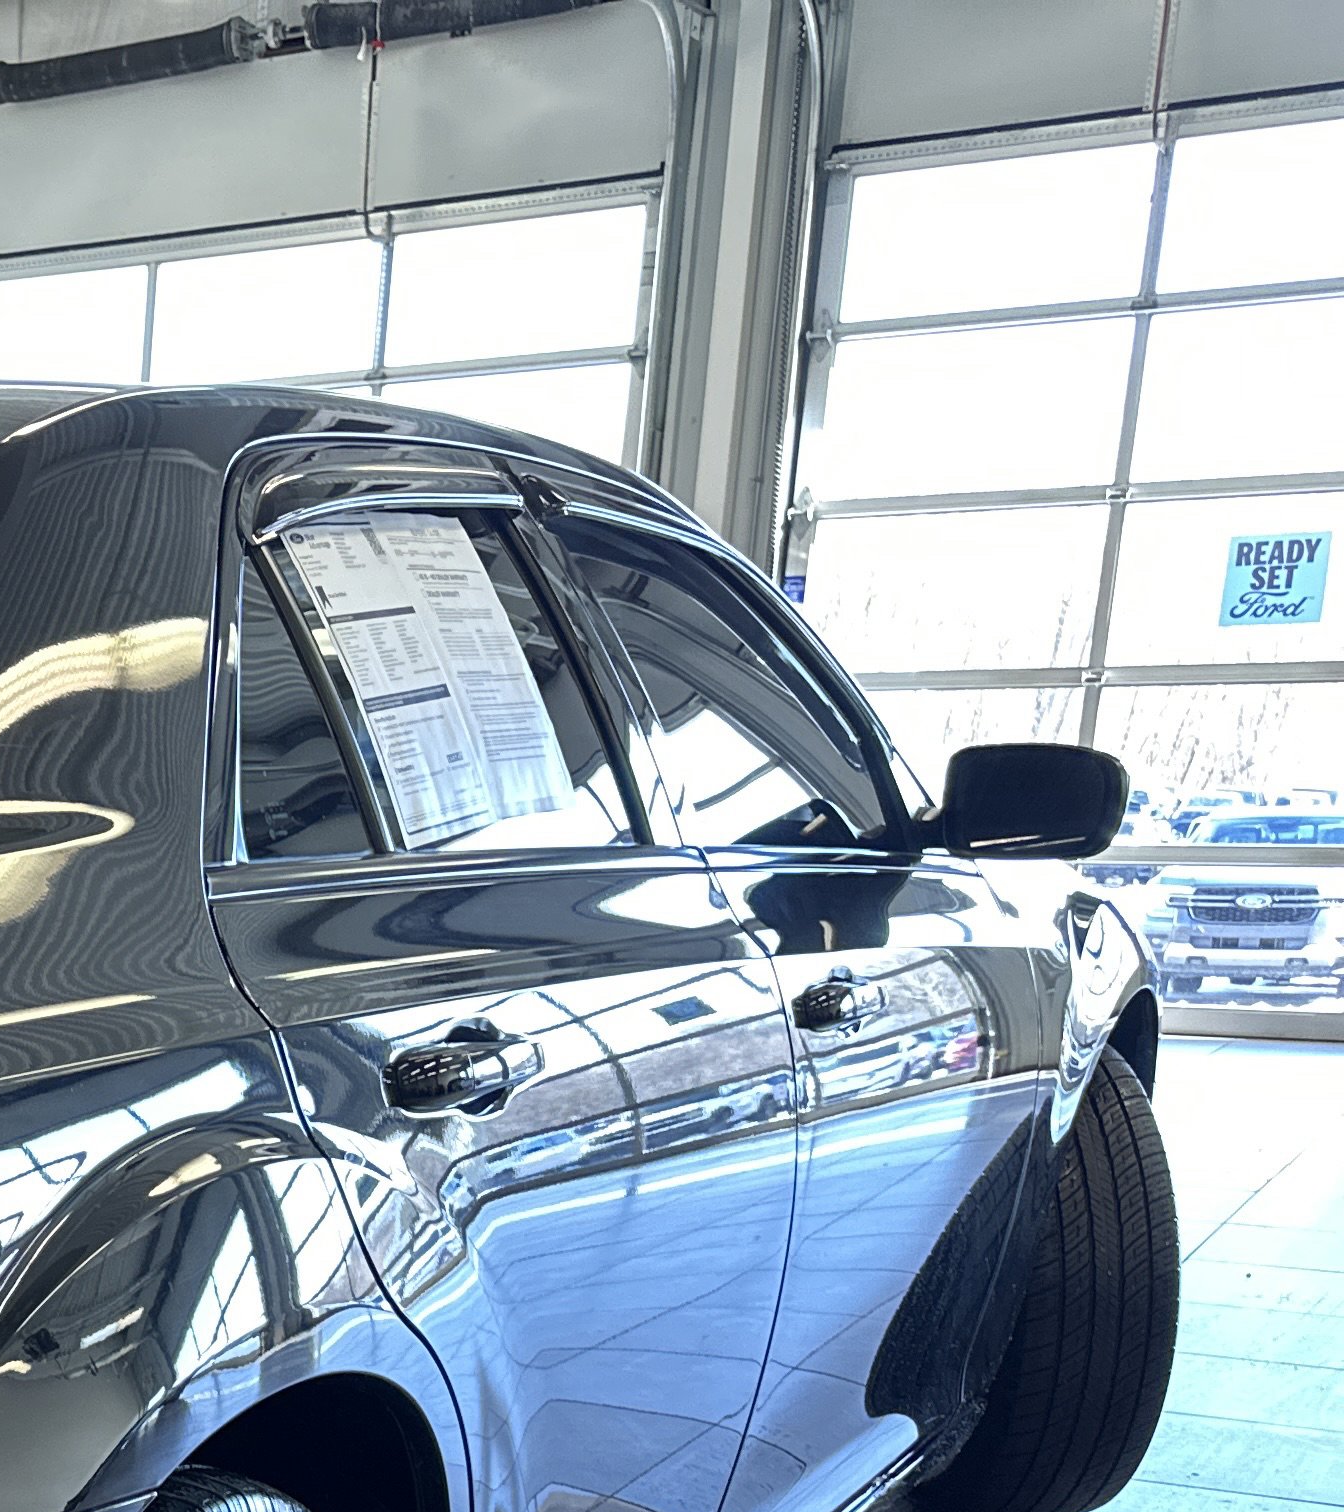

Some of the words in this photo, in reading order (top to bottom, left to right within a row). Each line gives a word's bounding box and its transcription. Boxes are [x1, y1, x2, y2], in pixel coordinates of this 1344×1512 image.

[1235, 538, 1322, 567] READY
[1249, 564, 1299, 590] SET
[1229, 591, 1307, 619] Ford
